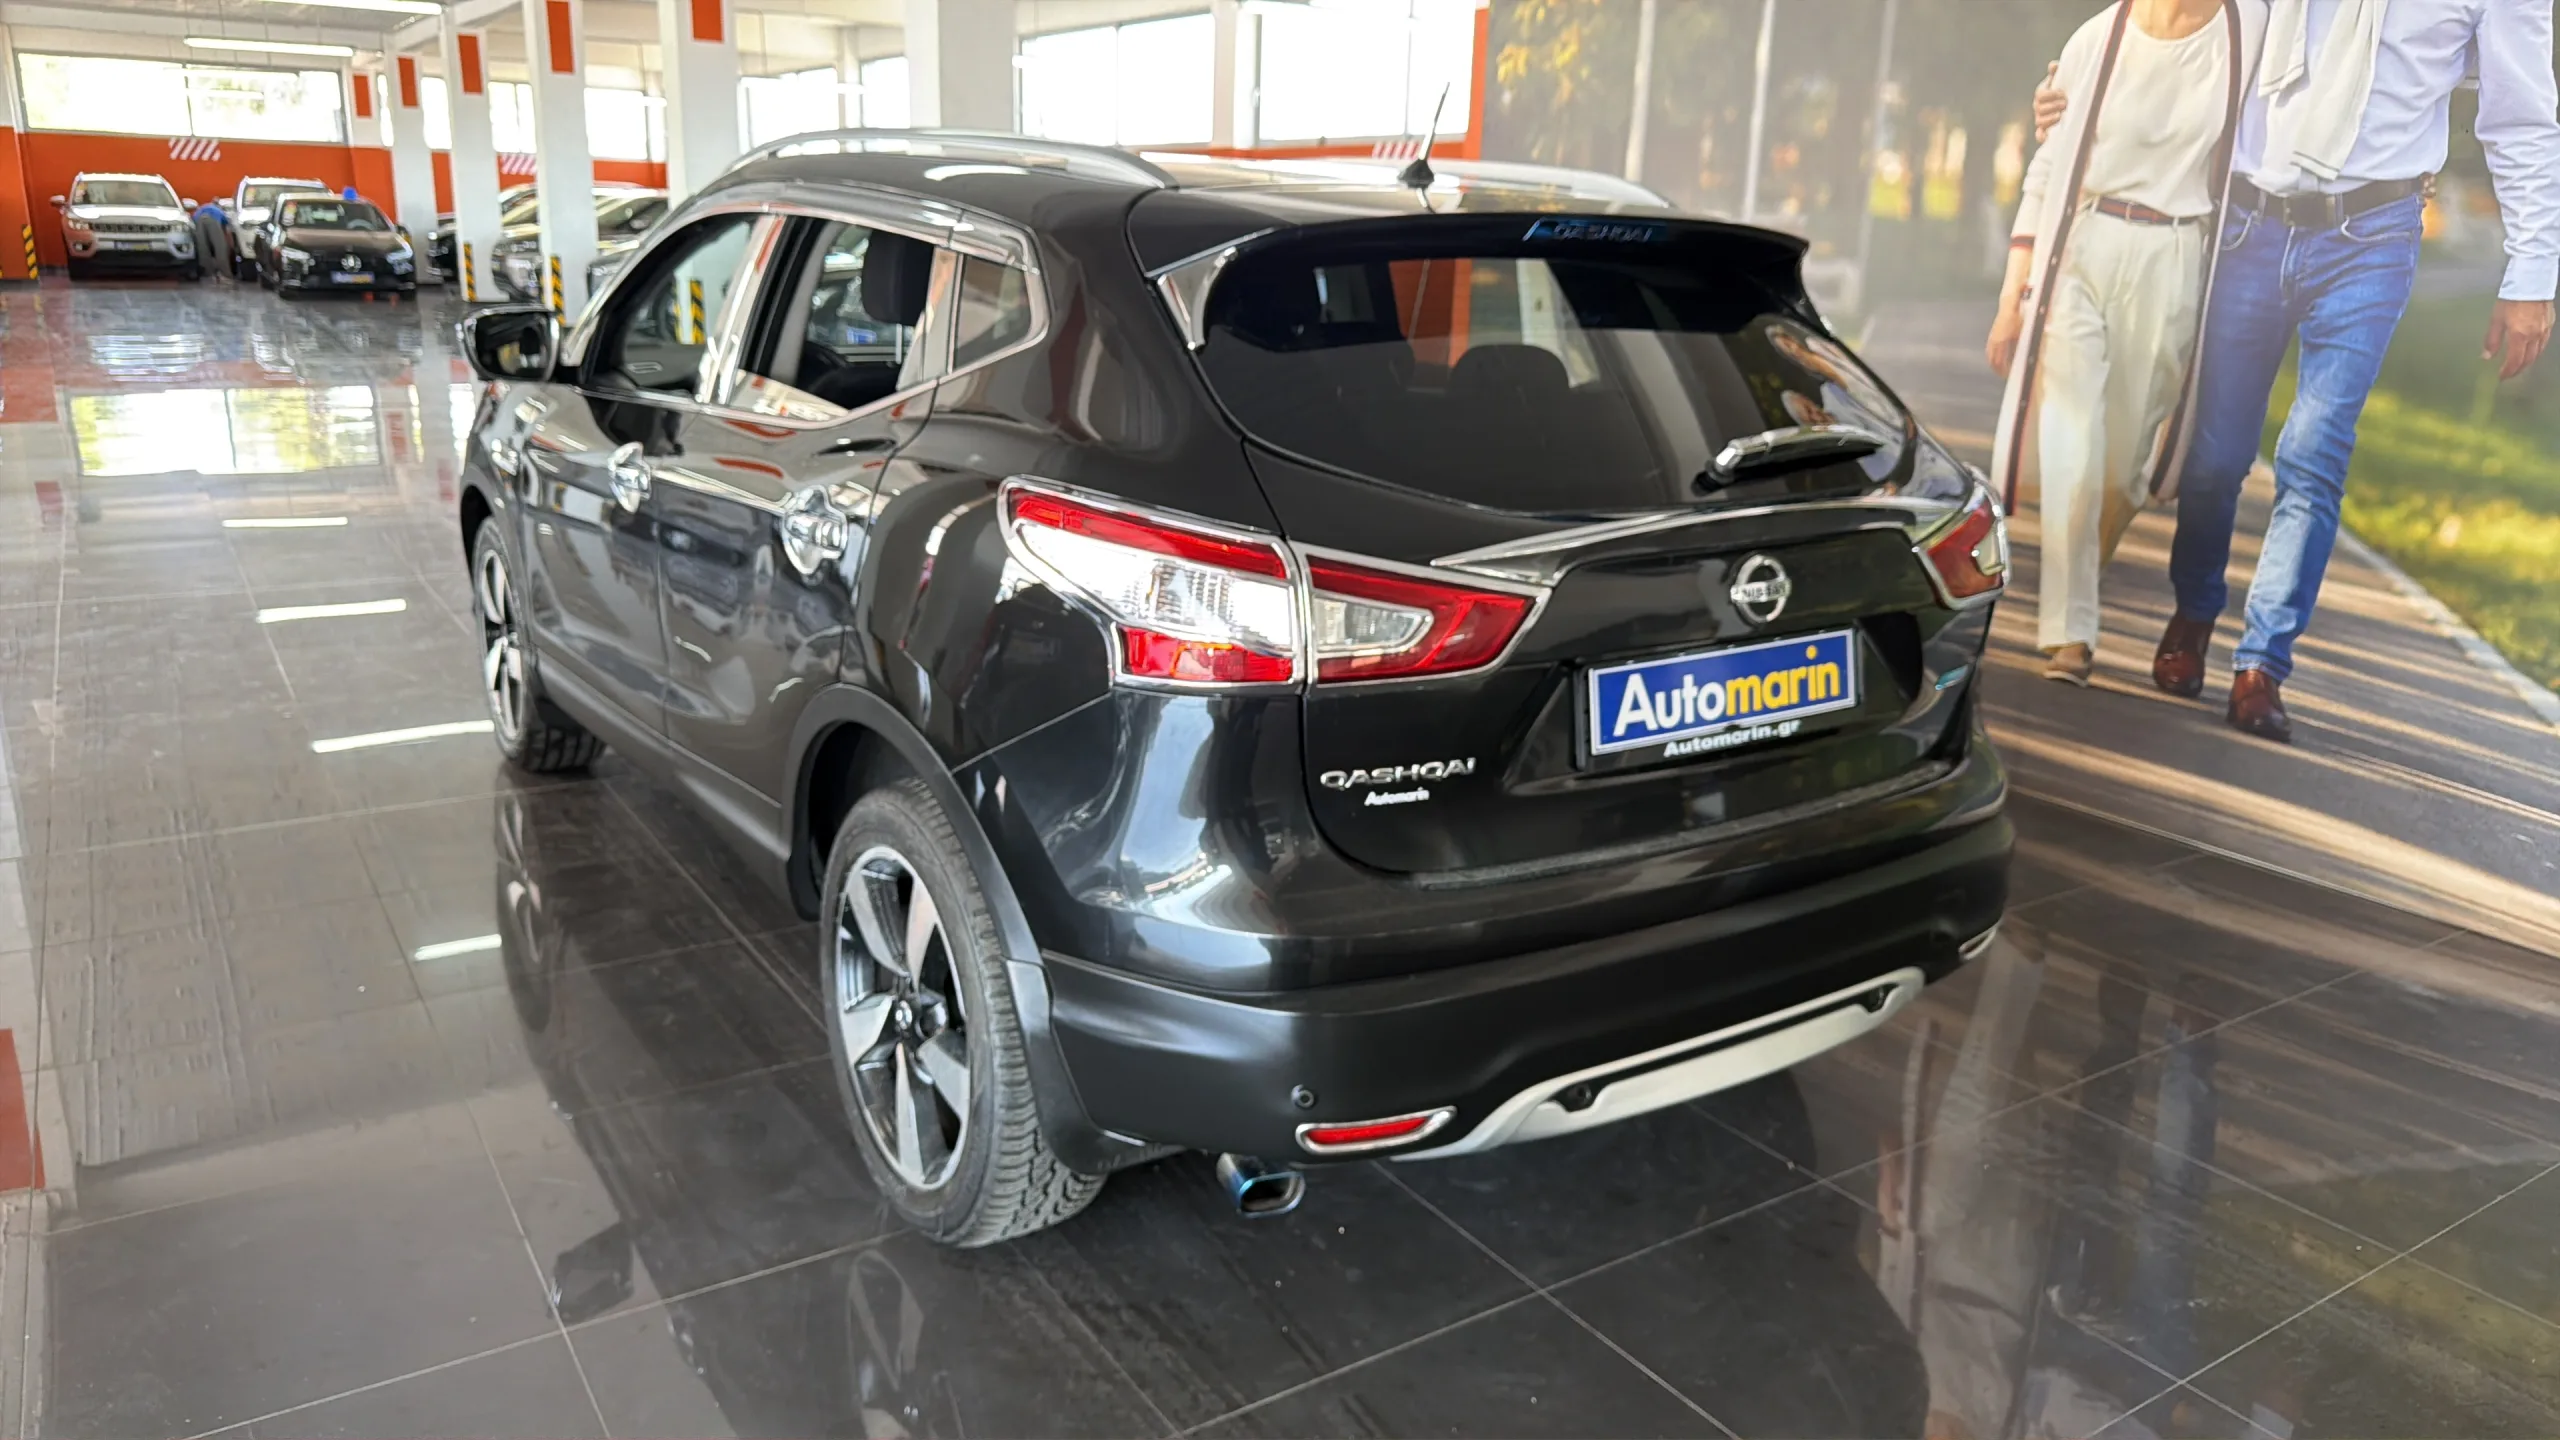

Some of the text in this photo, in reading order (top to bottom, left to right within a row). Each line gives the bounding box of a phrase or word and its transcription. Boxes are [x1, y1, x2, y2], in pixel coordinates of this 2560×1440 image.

[1612, 644, 1841, 737] Automarin
[1663, 719, 1802, 758] Automarin.gr
[1320, 757, 1477, 791] QASHQAI
